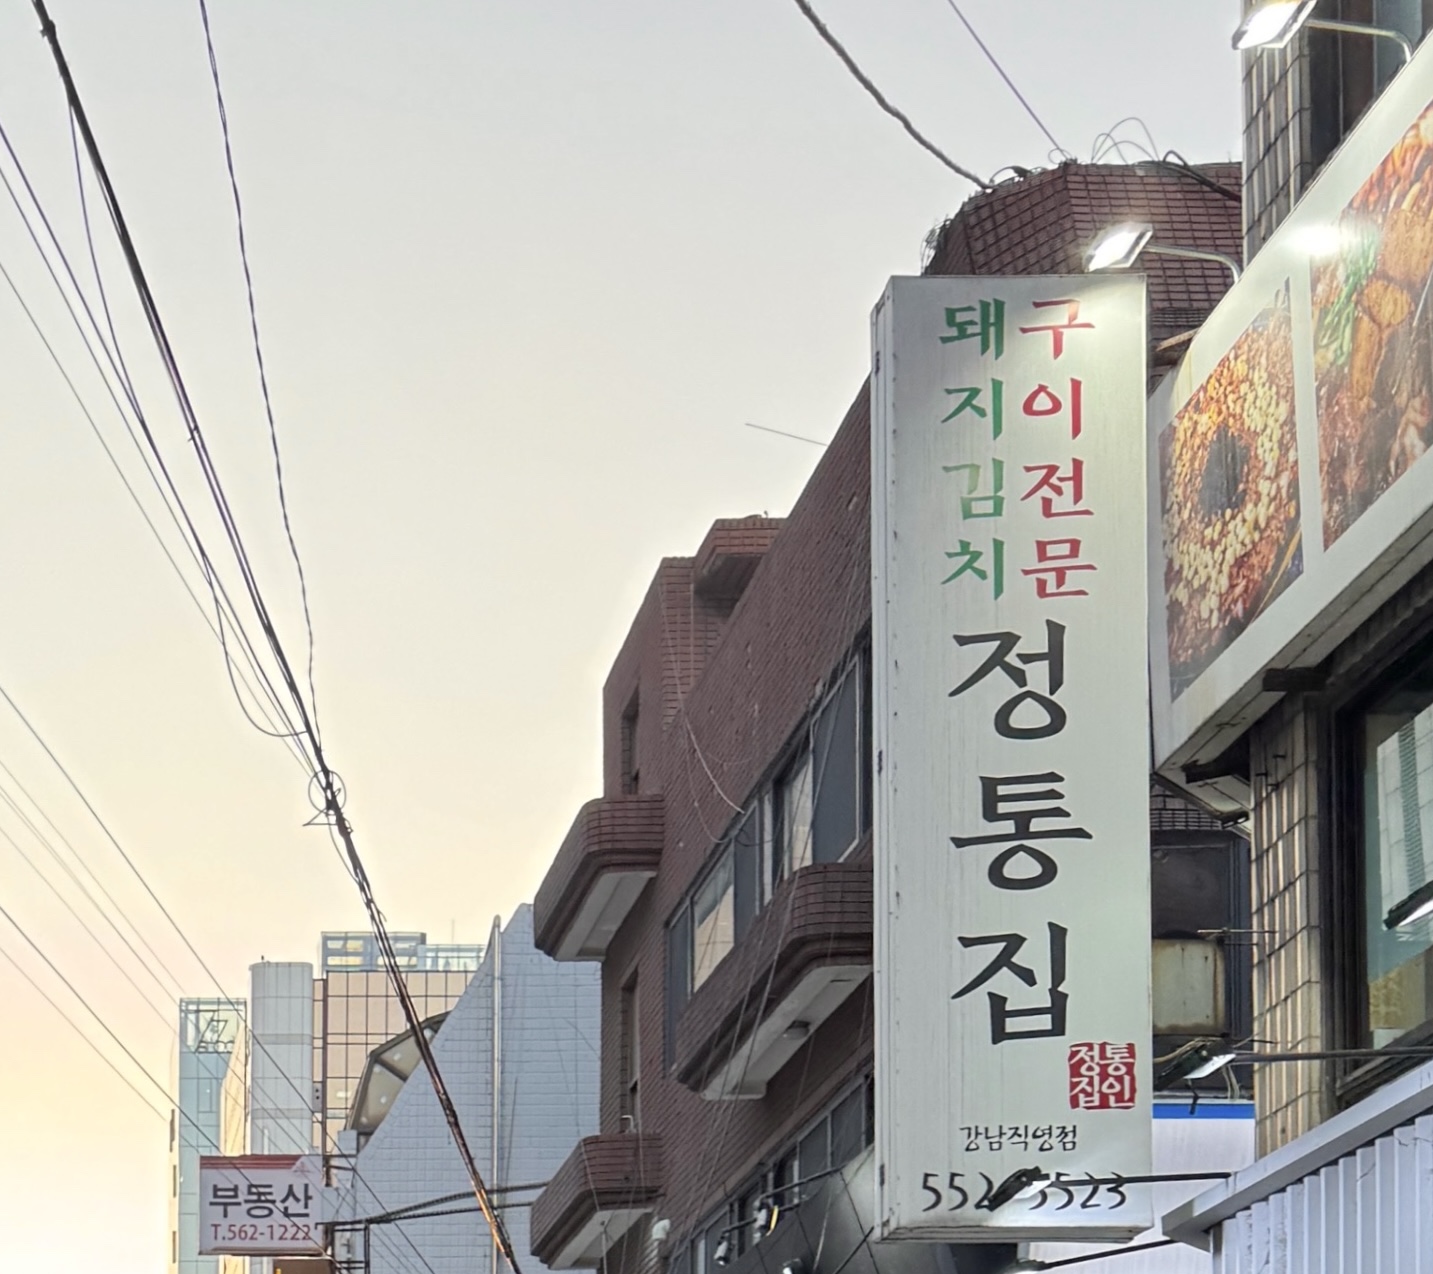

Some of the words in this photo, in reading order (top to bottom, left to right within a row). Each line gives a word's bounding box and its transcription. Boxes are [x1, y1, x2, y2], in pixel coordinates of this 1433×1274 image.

[938, 296, 1009, 602] 돼지김치
[1017, 296, 1100, 601] 구이전문
[947, 616, 1095, 1047] 정통집
[209, 1182, 314, 1219] 부동산
[959, 1124, 1078, 1152] 강남직영점
[210, 1222, 313, 1242] T.562-1222
